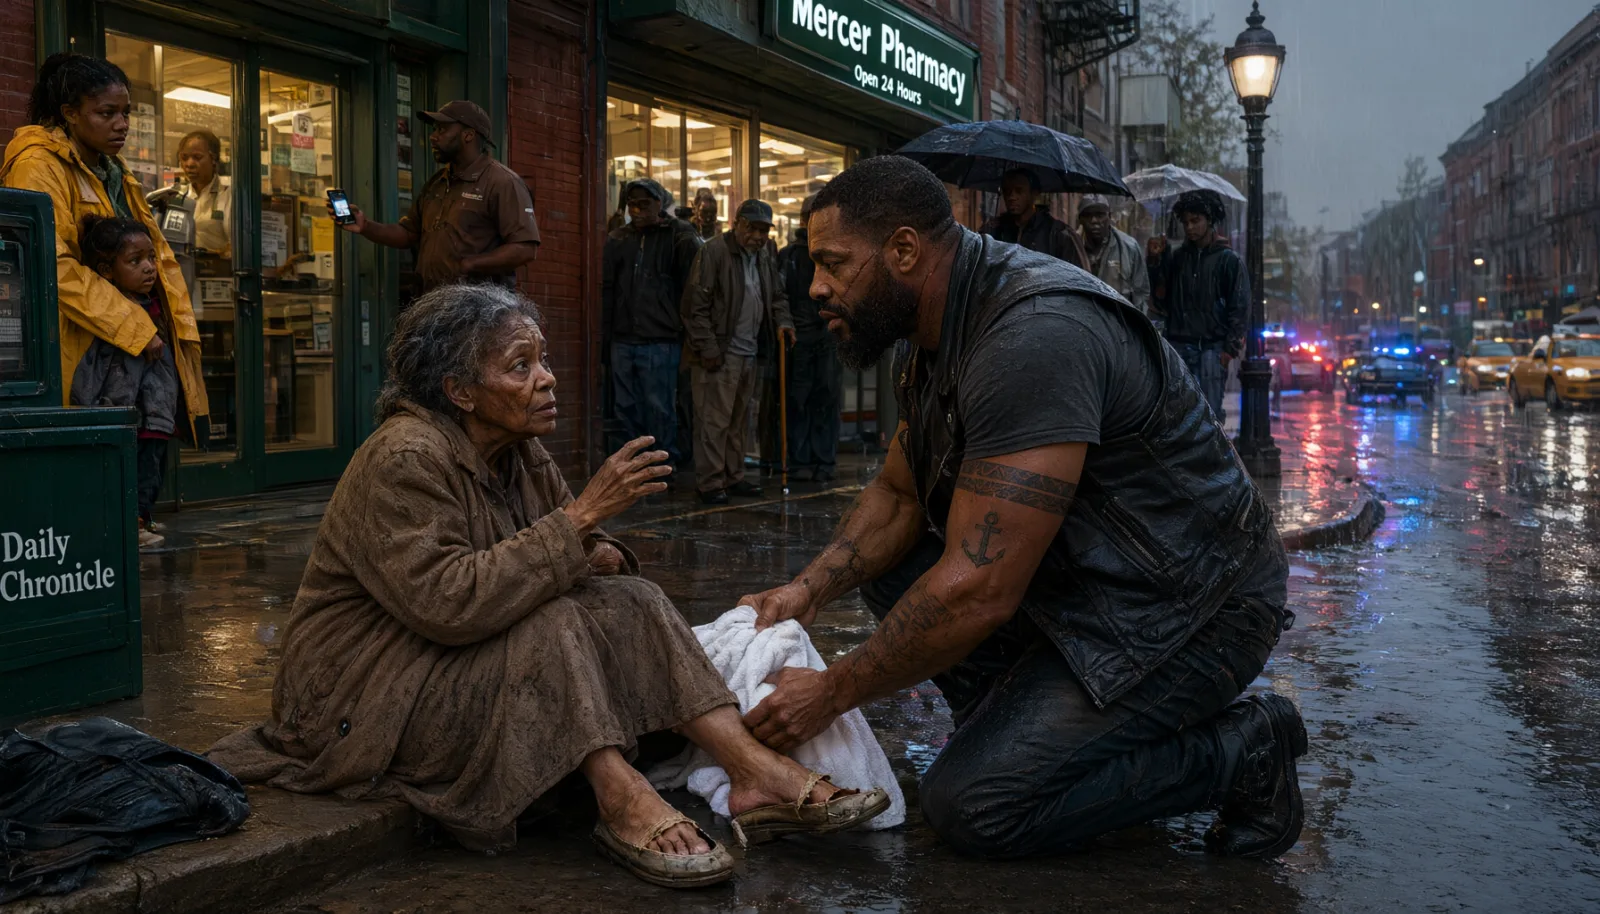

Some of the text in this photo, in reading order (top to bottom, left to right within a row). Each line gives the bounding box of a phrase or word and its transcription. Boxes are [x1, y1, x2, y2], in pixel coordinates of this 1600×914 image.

[792, 0, 966, 106] Mercer Pharmacy
[854, 64, 922, 105] Open 24 Hours
[0, 526, 71, 565] Daily
[0, 558, 115, 602] Chronicle
